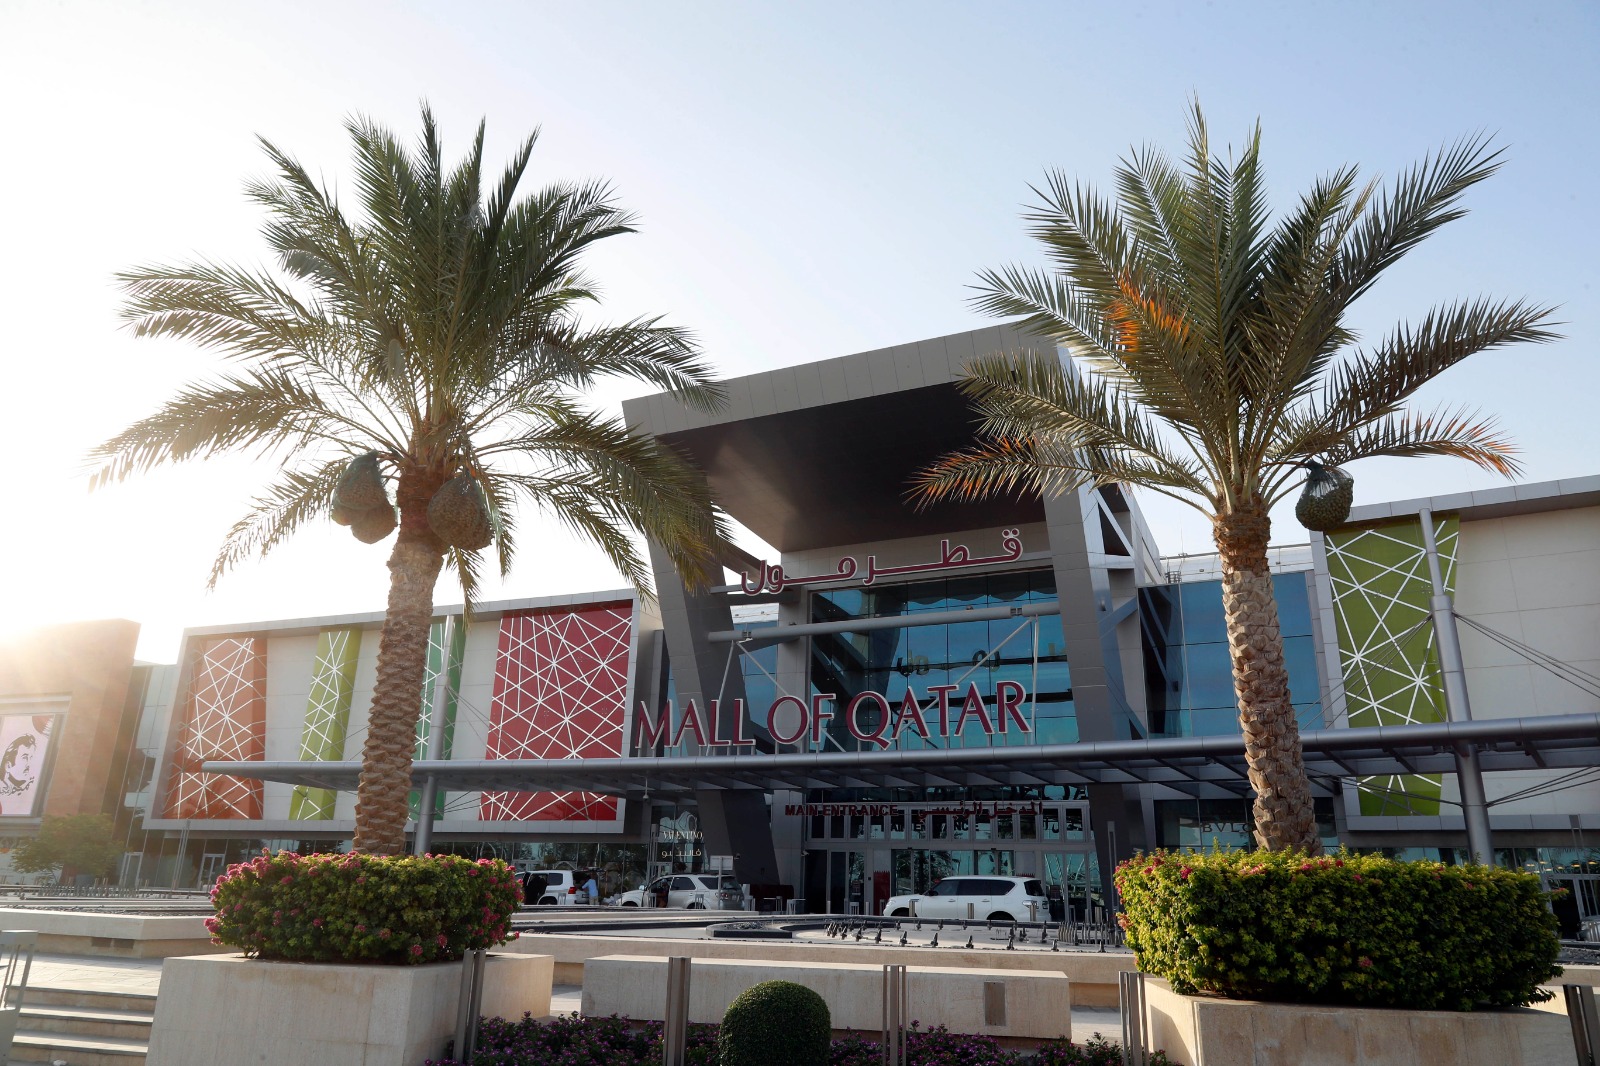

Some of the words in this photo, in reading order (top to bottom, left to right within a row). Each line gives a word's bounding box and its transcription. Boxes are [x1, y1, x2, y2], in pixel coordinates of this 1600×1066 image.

[740, 556, 858, 597] مول
[863, 527, 1024, 586] قطر
[634, 698, 757, 750] MALL
[766, 693, 837, 745] OF
[846, 681, 1033, 751] QATAR
[784, 804, 819, 817] MAIN
[822, 804, 899, 817] ENTRANCE
